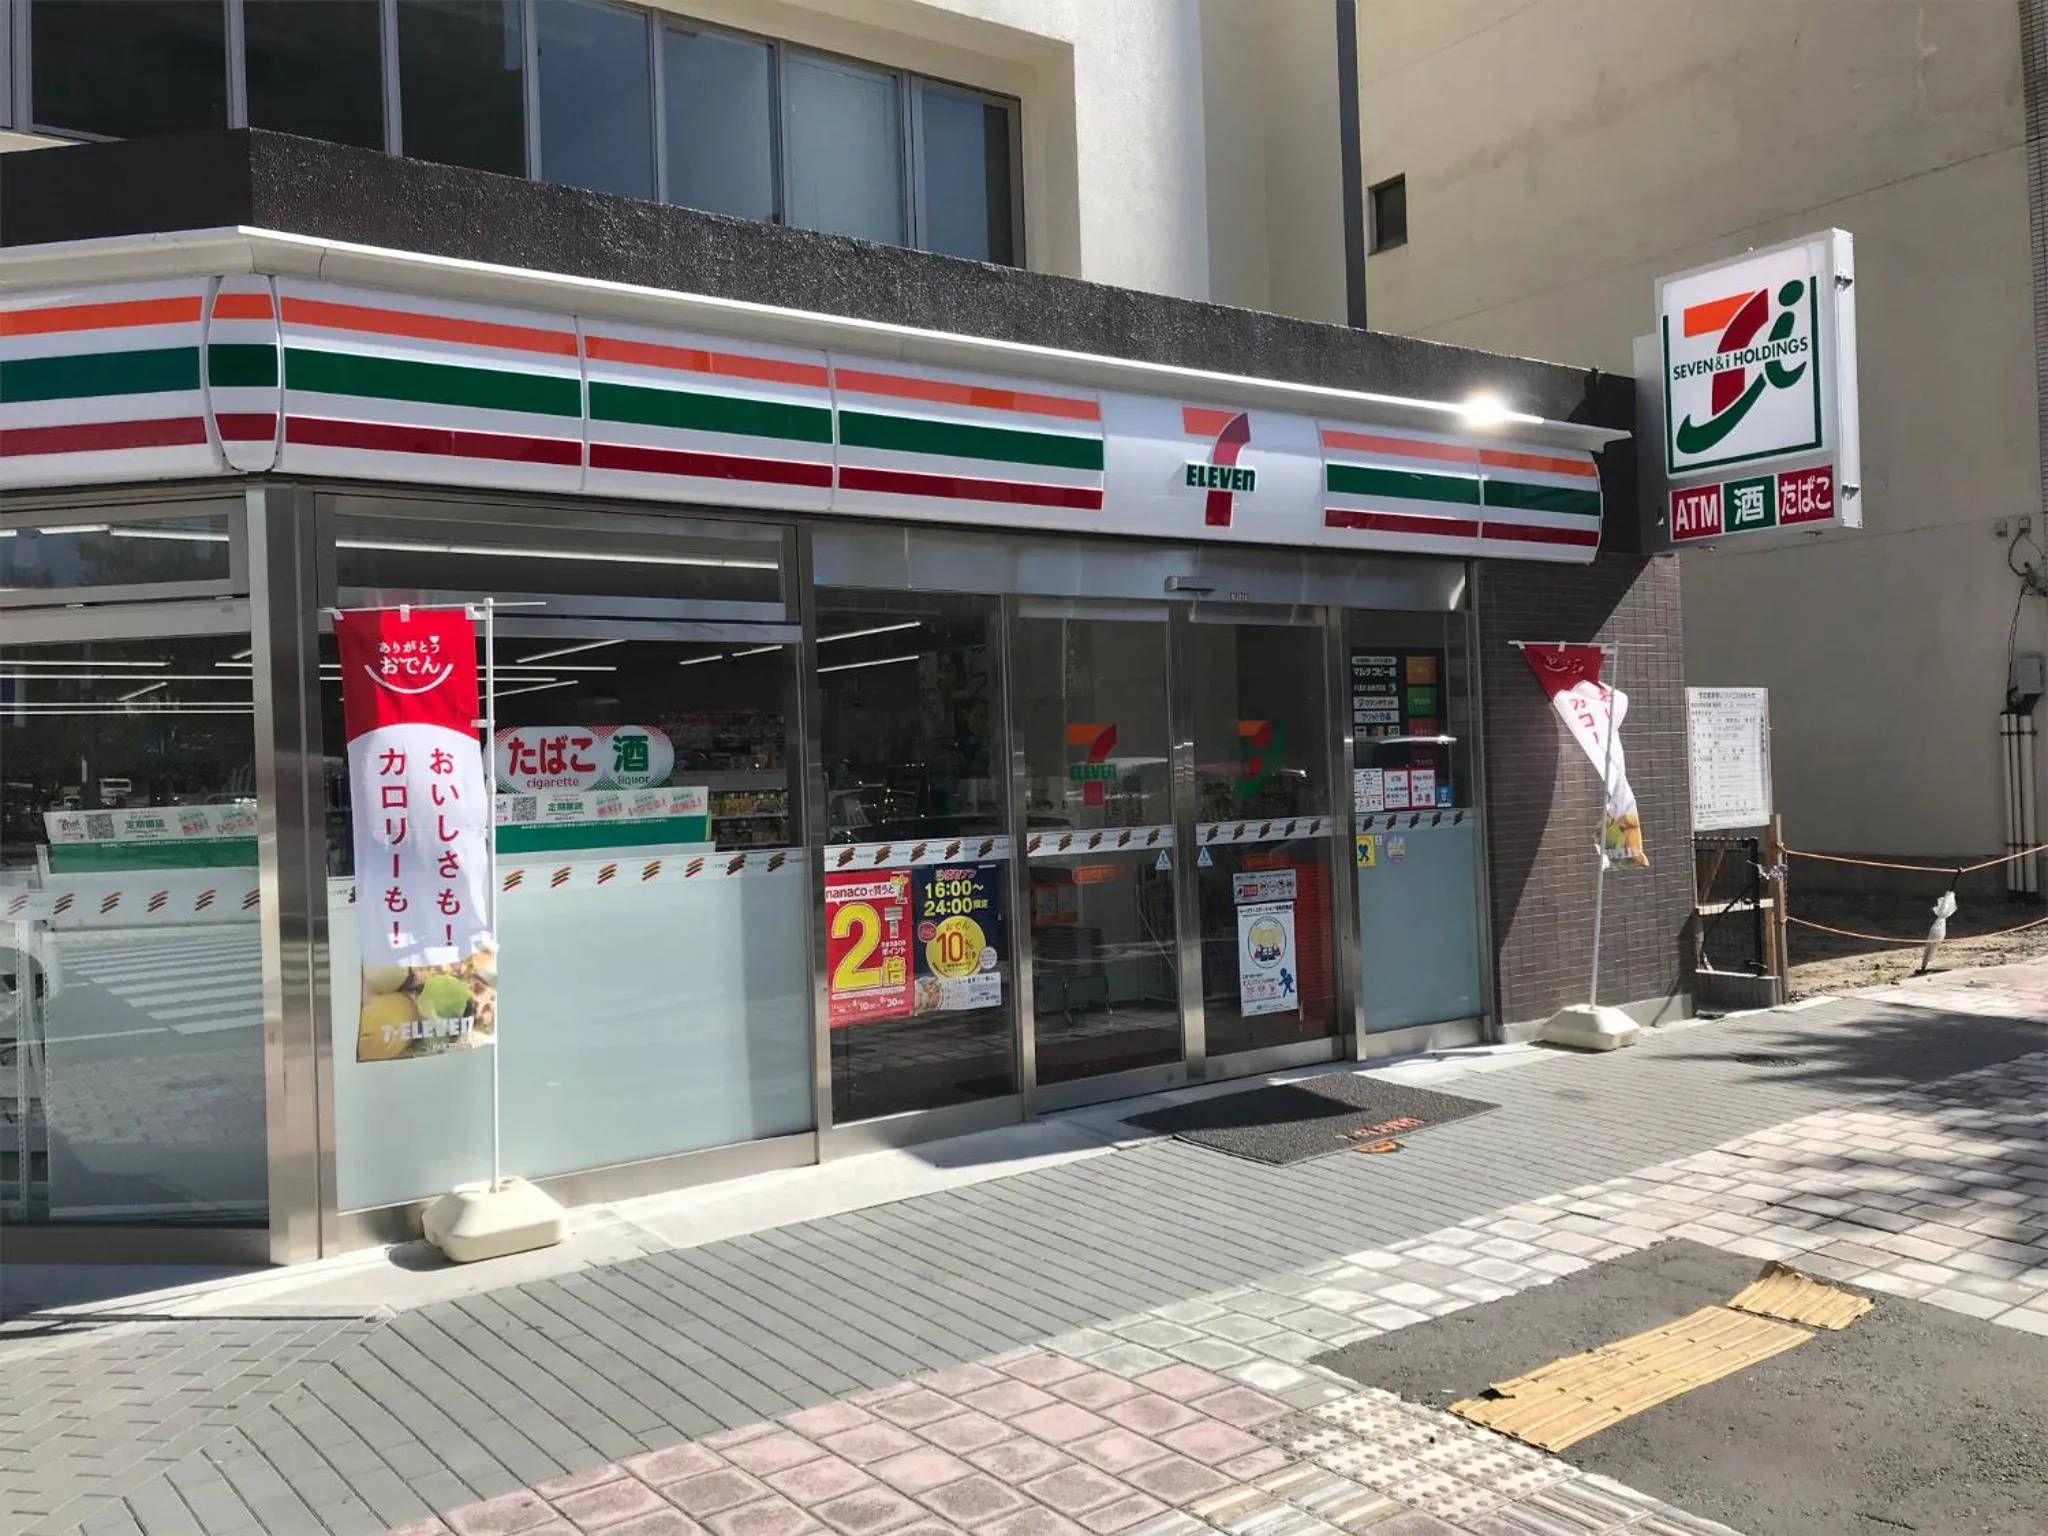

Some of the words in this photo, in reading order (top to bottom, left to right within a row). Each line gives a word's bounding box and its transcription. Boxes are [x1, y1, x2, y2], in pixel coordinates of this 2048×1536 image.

[1673, 355, 1731, 380] SEVEN&i
[1733, 337, 1809, 367] HOLDINGS
[1675, 494, 1719, 532] ATM
[1733, 485, 1765, 525] 酒
[1780, 475, 1832, 517] たばこ
[379, 641, 440, 654] ありがとう
[380, 656, 441, 675] おでん
[508, 734, 596, 776] たばこ
[613, 735, 649, 772] 酒
[526, 777, 580, 789] cigarette
[617, 775, 651, 786] liquor
[379, 748, 408, 945] カロリーも!
[429, 748, 460, 947] おいしさも!
[831, 902, 881, 992] 2
[936, 932, 964, 963] 10
